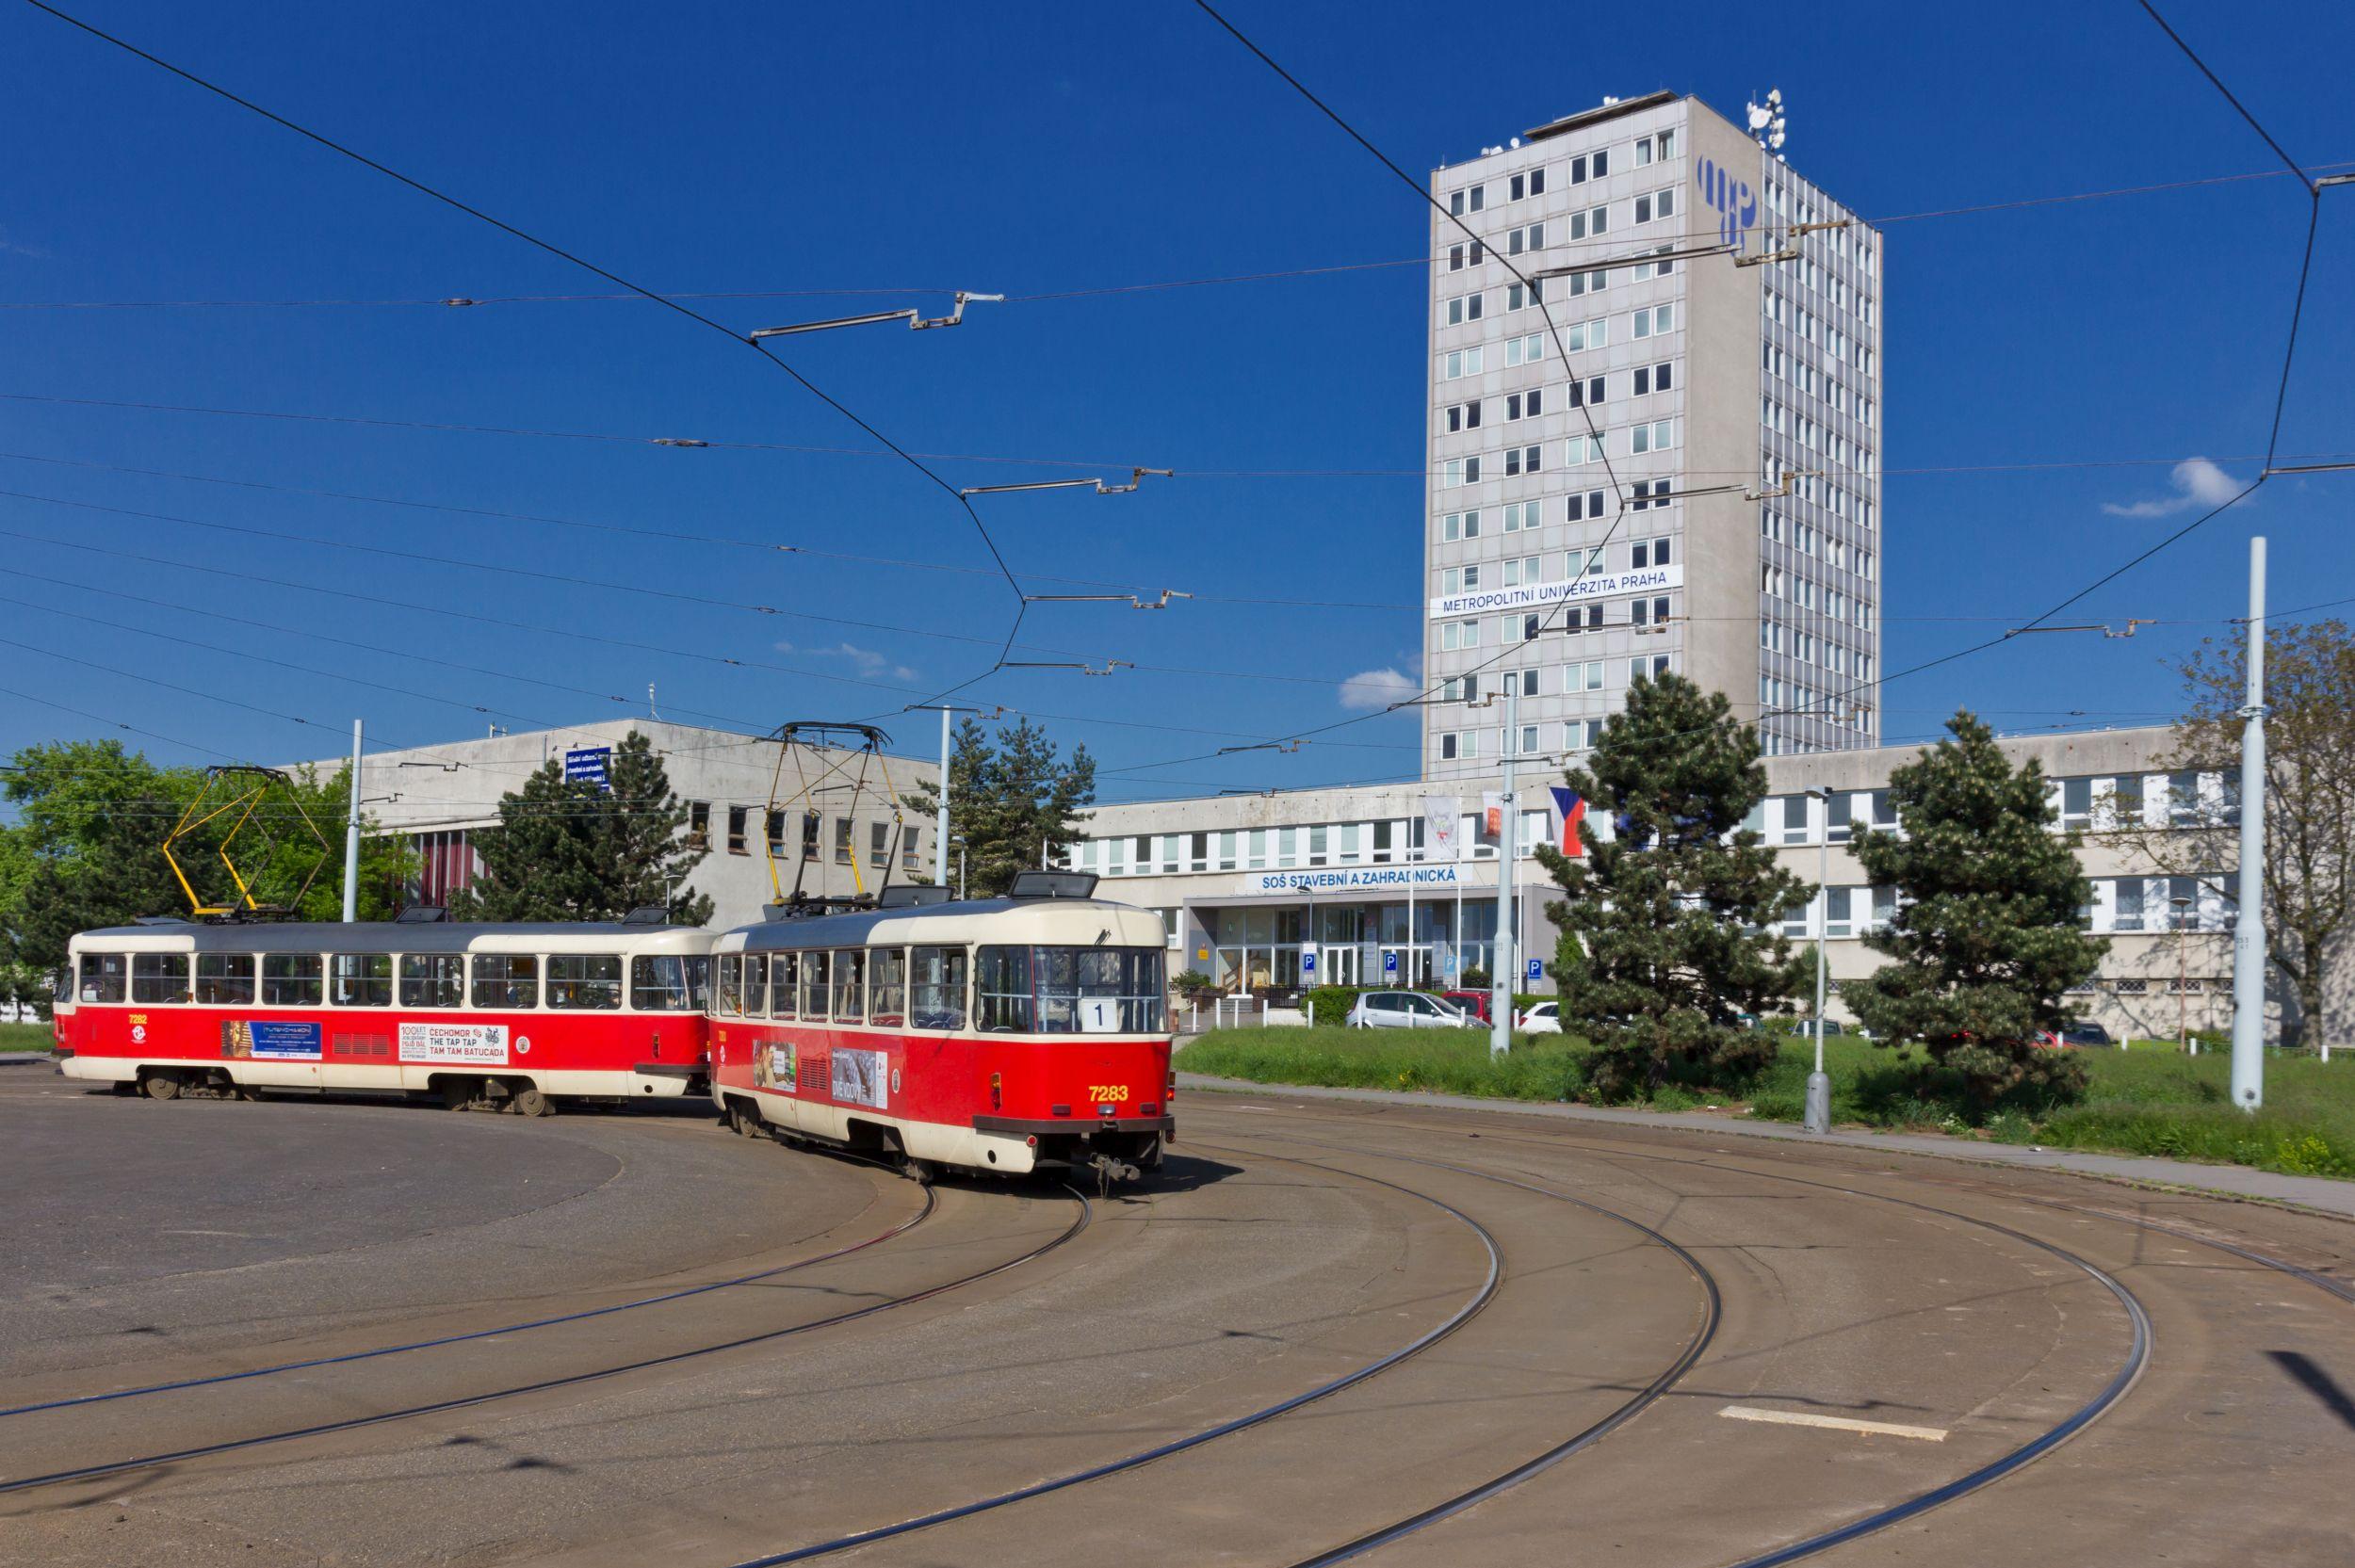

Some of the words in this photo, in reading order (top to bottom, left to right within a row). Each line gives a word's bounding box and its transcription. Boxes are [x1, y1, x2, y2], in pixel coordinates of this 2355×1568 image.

[1443, 587, 1535, 612] METROPOLITNÍ
[1539, 578, 1616, 600] UNIVERZITA
[1621, 572, 1667, 589] PRAHA
[1262, 873, 1287, 889] SOŠ
[1290, 869, 1348, 887] STAVEBNÍ
[1351, 872, 1359, 885] A
[1362, 865, 1456, 884] ZAHRADNICKÁ
[1306, 955, 1314, 968] P
[1387, 955, 1395, 968] P
[1530, 961, 1539, 974] P
[128, 1014, 148, 1025] 7282
[1095, 1003, 1103, 1026] 1
[400, 1026, 416, 1035] 100
[446, 1038, 461, 1046] TAP
[430, 1046, 445, 1055] TAM
[447, 1047, 463, 1056] TAM
[464, 1047, 505, 1057] BATUCADA
[1088, 1085, 1129, 1102] 7283
